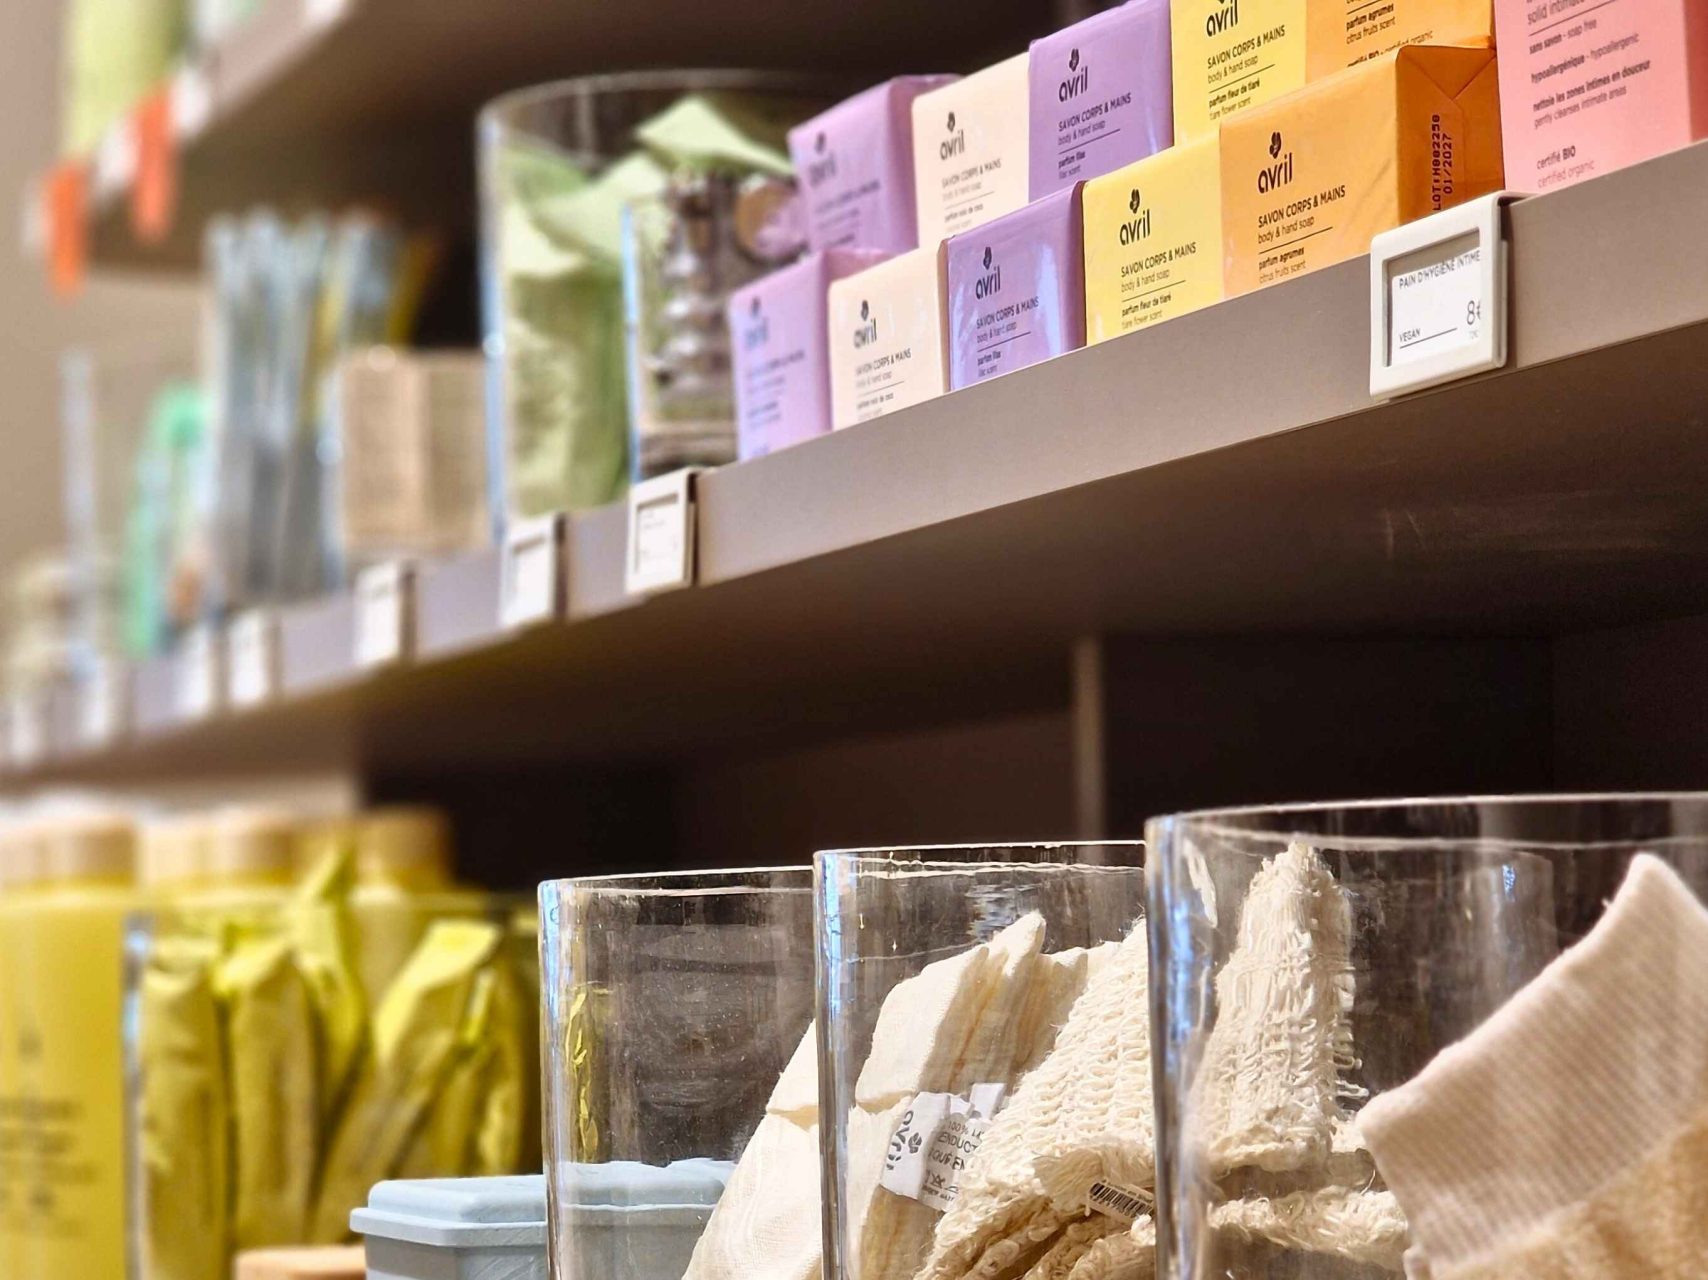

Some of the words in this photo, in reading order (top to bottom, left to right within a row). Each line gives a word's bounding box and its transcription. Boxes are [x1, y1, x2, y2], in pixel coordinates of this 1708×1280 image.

[1206, 0, 1238, 37] avril
[1207, 49, 1230, 69] SAVON
[1232, 38, 1255, 58] CORPS
[1257, 35, 1261, 47] &
[1263, 24, 1285, 44] MAINS
[1058, 66, 1088, 102] avril
[1058, 116, 1080, 132] SAVON
[1081, 104, 1103, 122] CORPS
[1110, 93, 1131, 110] MAINS
[940, 129, 965, 160] avril
[1562, 145, 1576, 160] BIO
[1258, 152, 1292, 194] avril
[1443, 132, 1453, 194] 01/2027
[1258, 207, 1284, 228] SAVON
[1286, 197, 1312, 218] CORPS
[1313, 194, 1318, 208] &
[1320, 185, 1346, 205] MAINS
[1120, 208, 1151, 246] avril
[1258, 230, 1274, 244] body
[1275, 226, 1280, 238] &
[1282, 219, 1298, 236] hand
[1299, 216, 1315, 230] soap
[1121, 260, 1143, 278] SAVON
[1145, 251, 1167, 269] CORPS
[1169, 249, 1173, 261] &
[1175, 242, 1196, 259] MAINS
[1280, 247, 1304, 263] agrumes
[976, 266, 1001, 299] avril
[1399, 275, 1416, 289] PAIN
[976, 314, 995, 329] SAVON
[996, 304, 1015, 322] CORPS
[1021, 296, 1039, 312] MAINS
[854, 317, 877, 349] avril
[1399, 327, 1421, 342] VEGAN
